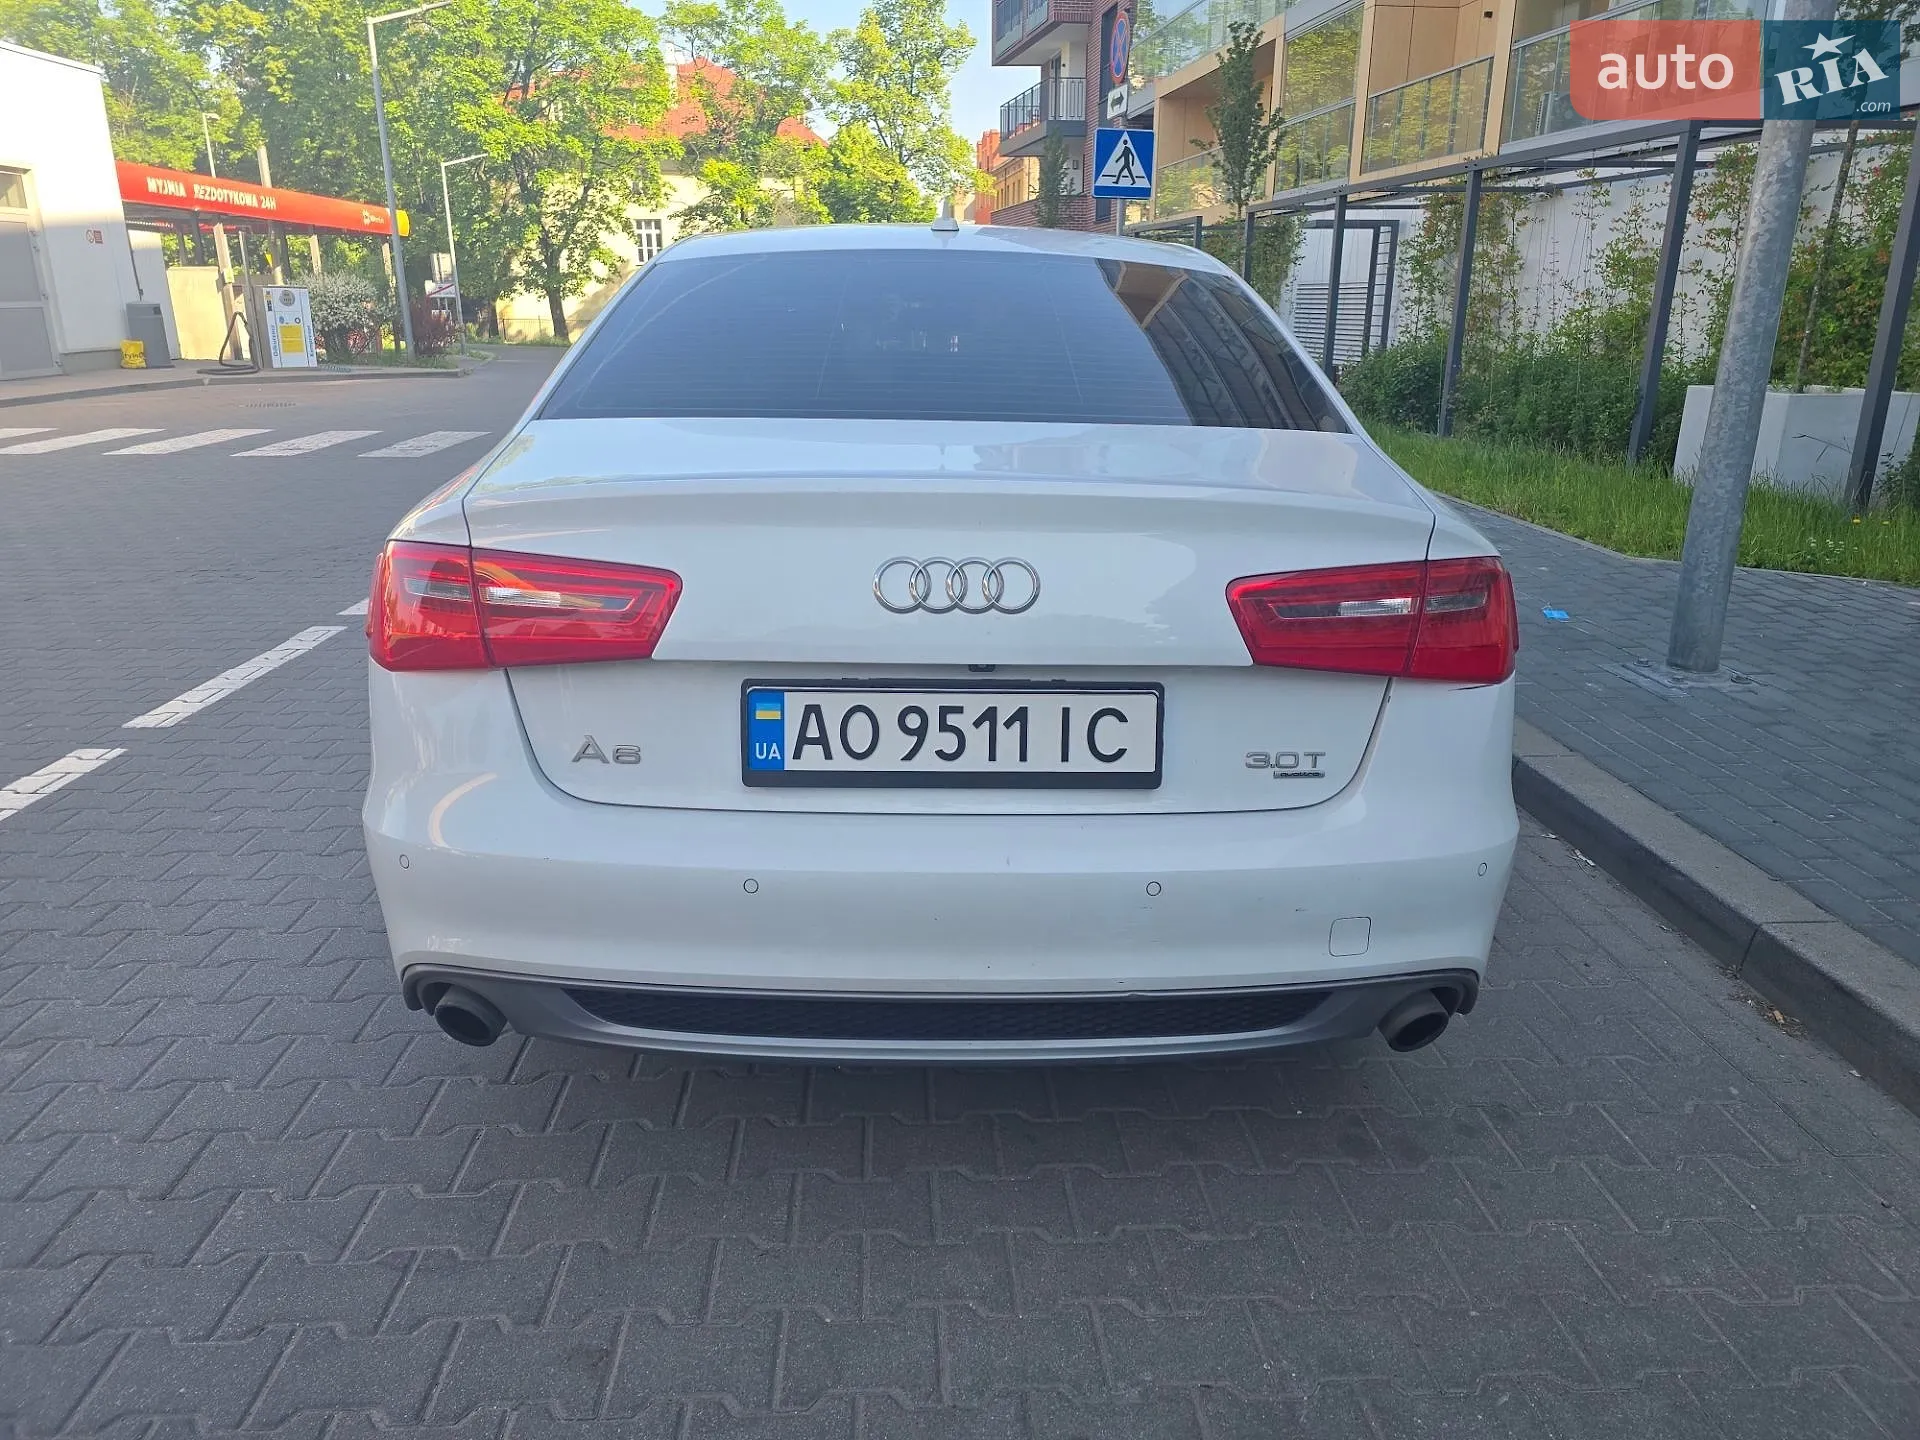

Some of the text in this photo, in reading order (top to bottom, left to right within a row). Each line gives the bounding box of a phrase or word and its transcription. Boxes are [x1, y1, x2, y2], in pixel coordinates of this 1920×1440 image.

[260, 195, 277, 210] 24H
[792, 703, 1130, 764] AO 9511 IC
[571, 734, 642, 765] A6
[755, 742, 782, 760] UA
[1245, 751, 1326, 769] 3.0T
